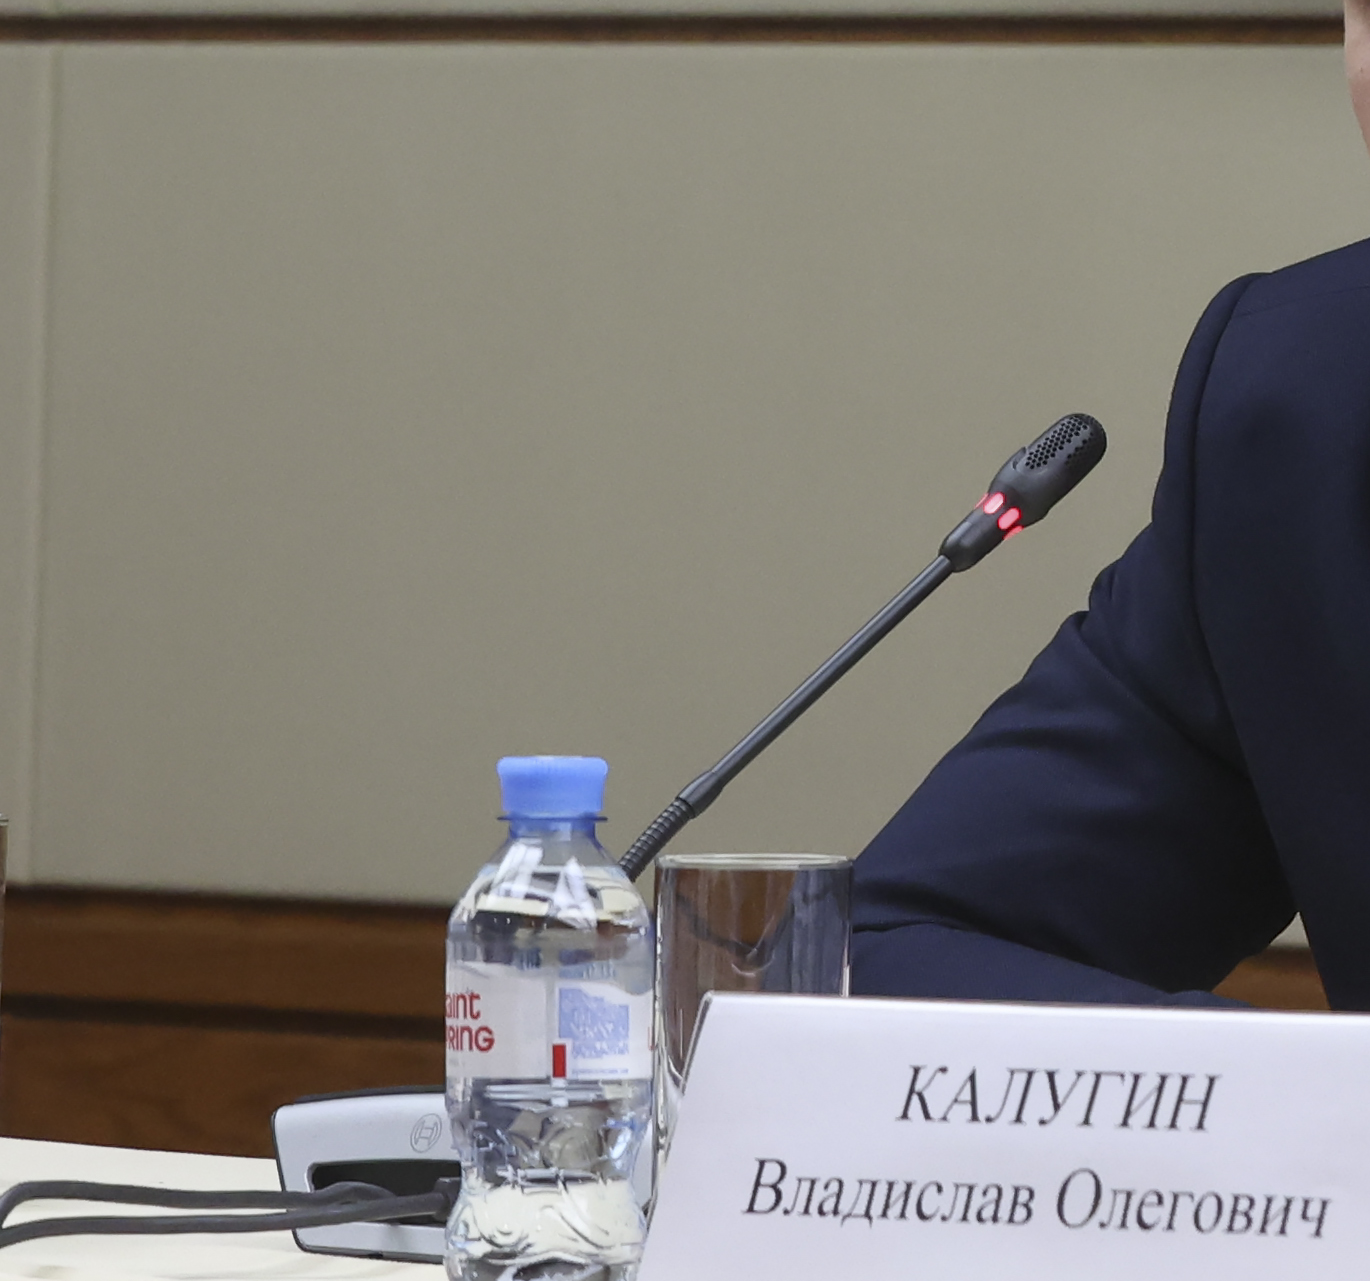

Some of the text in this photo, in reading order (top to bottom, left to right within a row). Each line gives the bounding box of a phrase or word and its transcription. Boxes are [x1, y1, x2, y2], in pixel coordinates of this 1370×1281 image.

[446, 991, 481, 1020] aint
[446, 1026, 495, 1053] RING
[897, 1064, 1221, 1132] КАЛУГИН
[743, 1157, 1332, 1239] Владислав Олегович
